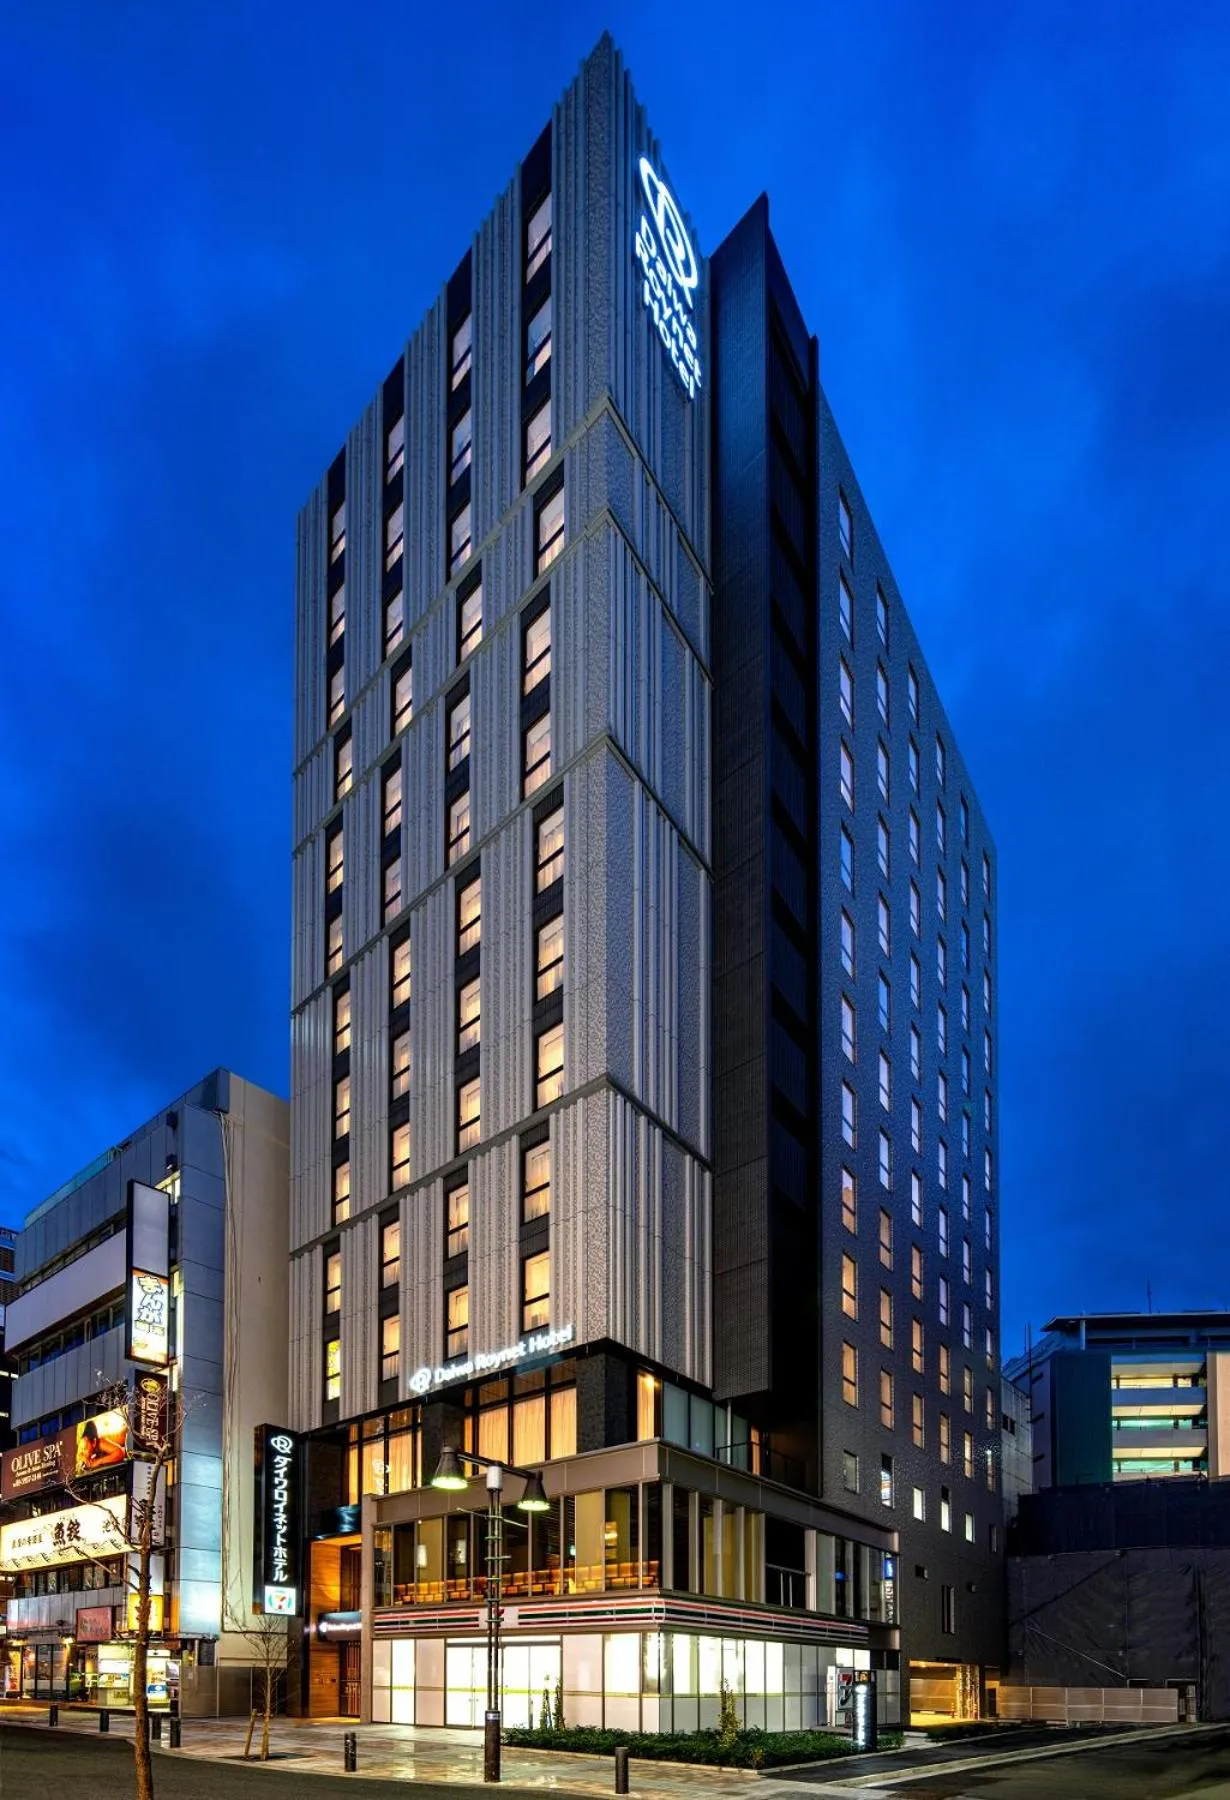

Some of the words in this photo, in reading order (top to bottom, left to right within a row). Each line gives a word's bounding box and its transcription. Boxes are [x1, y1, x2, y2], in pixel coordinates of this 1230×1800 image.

[644, 280, 695, 398] Hotel
[434, 1361, 473, 1383] Daiwa
[475, 1342, 526, 1370] Roynet
[529, 1323, 573, 1352] Hotel
[11, 1448, 41, 1472] OLIVE
[43, 1443, 62, 1461] SPA
[273, 1456, 292, 1582] ダイワロイネットホテル
